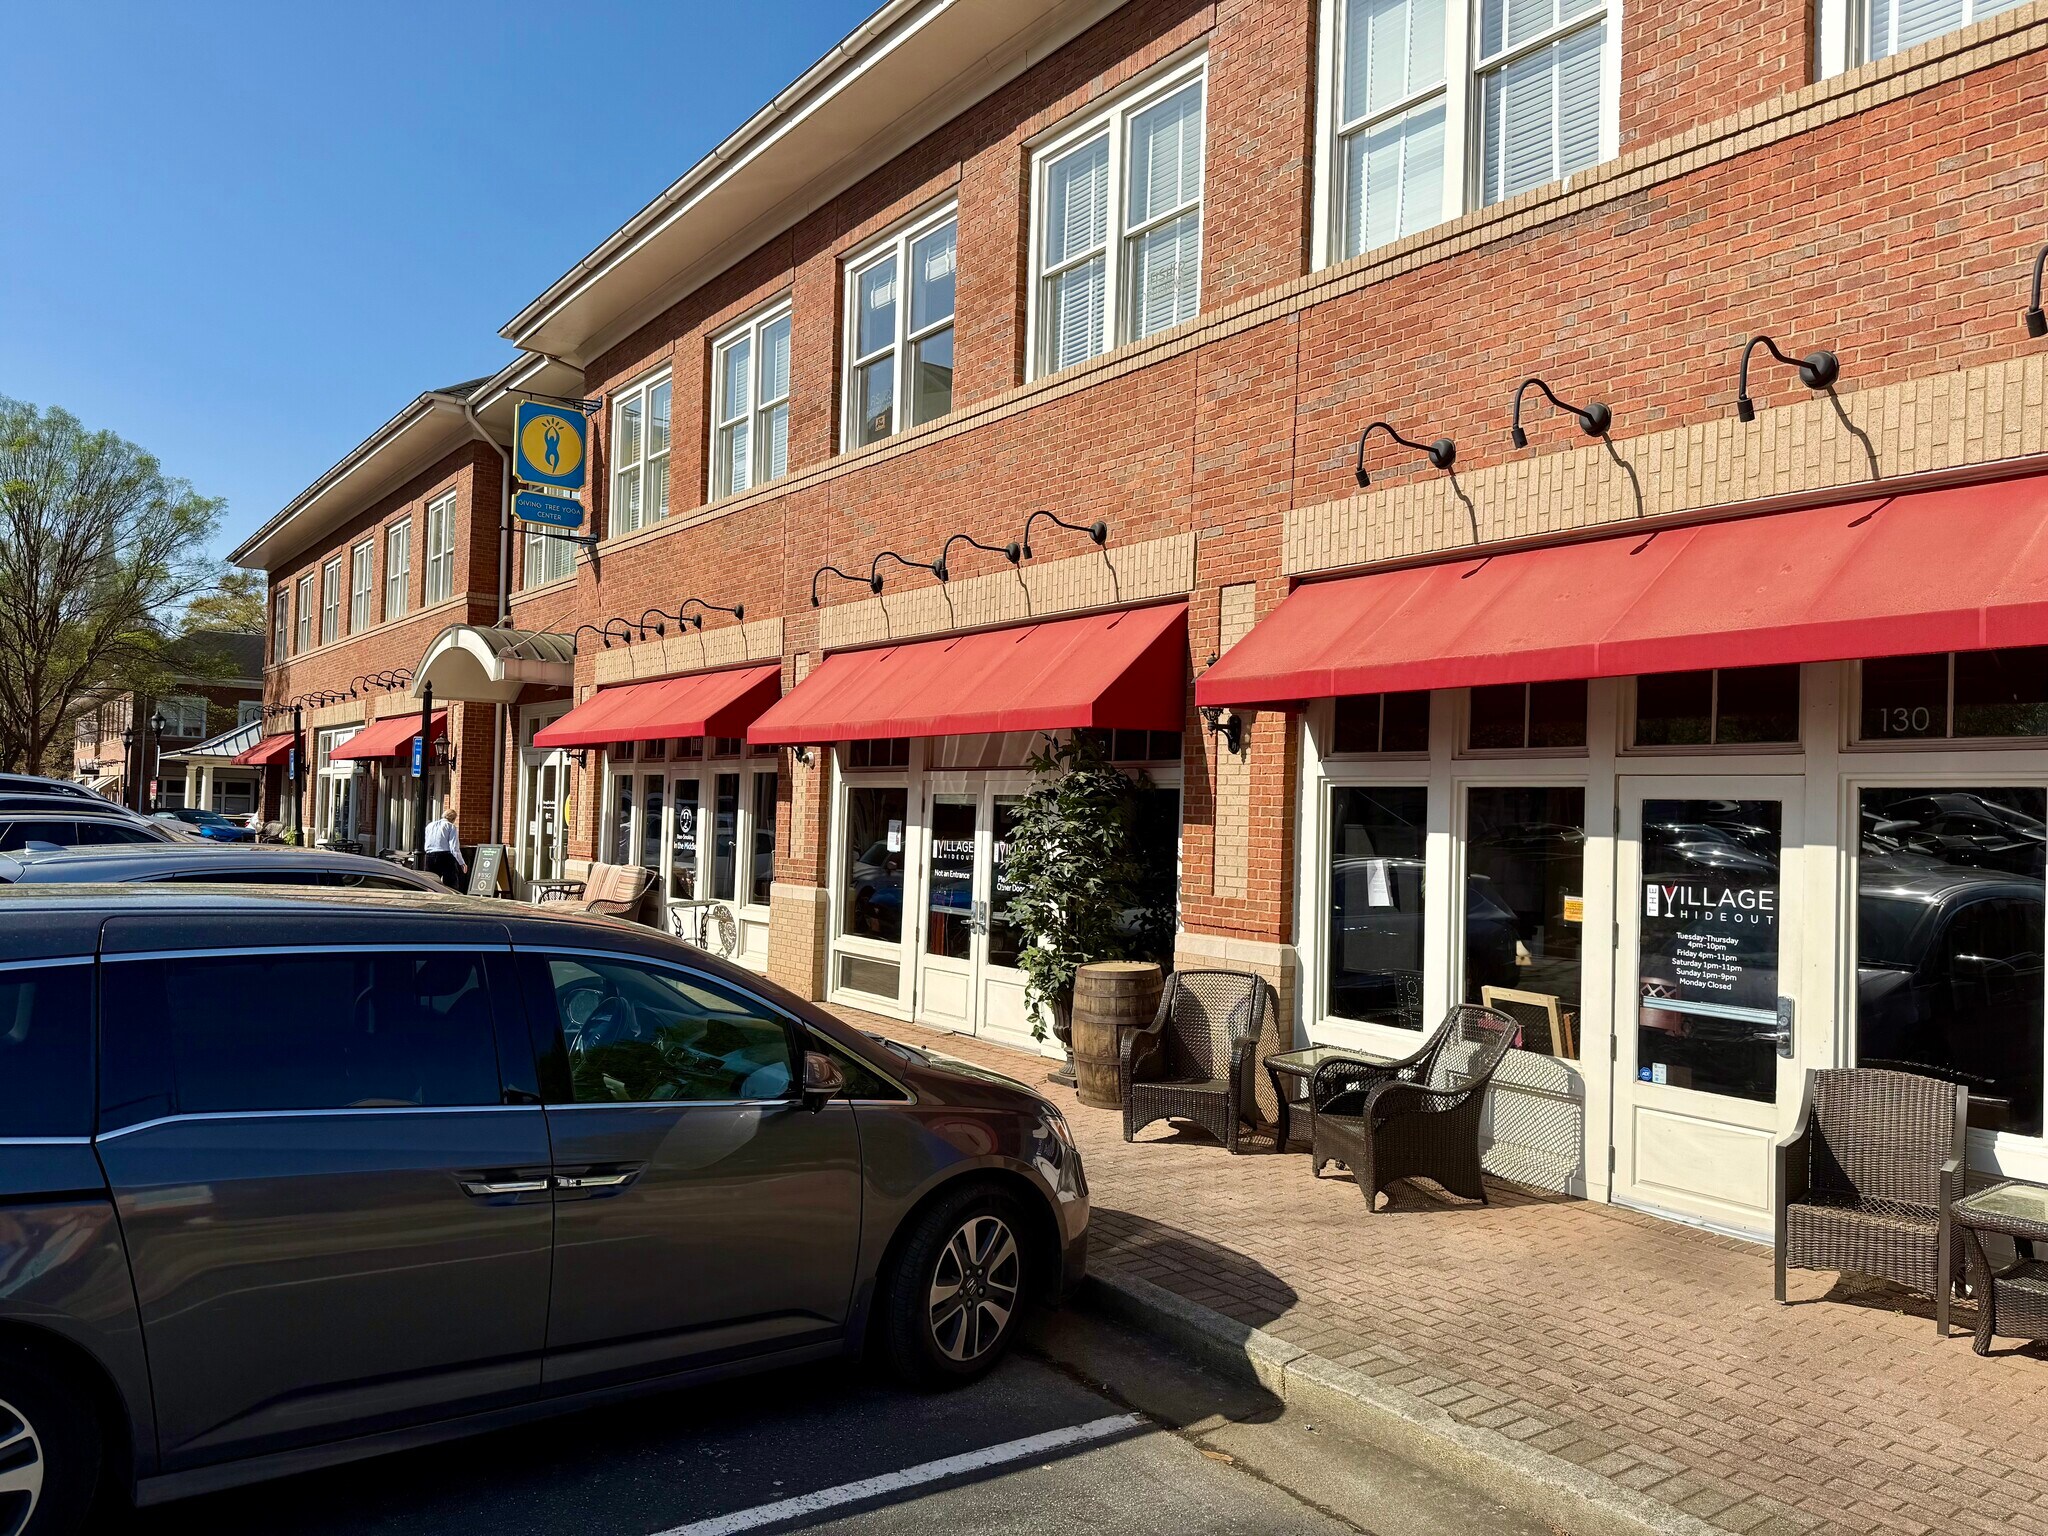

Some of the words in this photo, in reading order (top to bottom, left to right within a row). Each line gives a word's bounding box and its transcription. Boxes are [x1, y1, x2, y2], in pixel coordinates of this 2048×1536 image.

[537, 511, 562, 521] CENTER
[545, 503, 561, 512] TREE
[562, 506, 581, 515] YOGA
[1880, 706, 1930, 732] 130
[937, 840, 975, 858] VILLAGE
[935, 869, 944, 877] Not
[950, 870, 971, 880] Entrance
[1661, 883, 1774, 917] VILLAGE
[1680, 909, 1774, 925] HIDEOUT
[1676, 931, 1739, 946] Tuesday-Thursday
[1687, 940, 1727, 951] 4pm-10pm
[1676, 948, 1697, 959] Friday
[1698, 951, 1738, 962] 4pm-11pm
[1671, 957, 1702, 969] Saturday
[1703, 961, 1743, 972] 1pm-11pm
[1676, 967, 1702, 978] Sunday
[1702, 971, 1737, 982] 1pm-9pm
[1679, 977, 1706, 989] Monday
[1707, 980, 1732, 991] Closed
